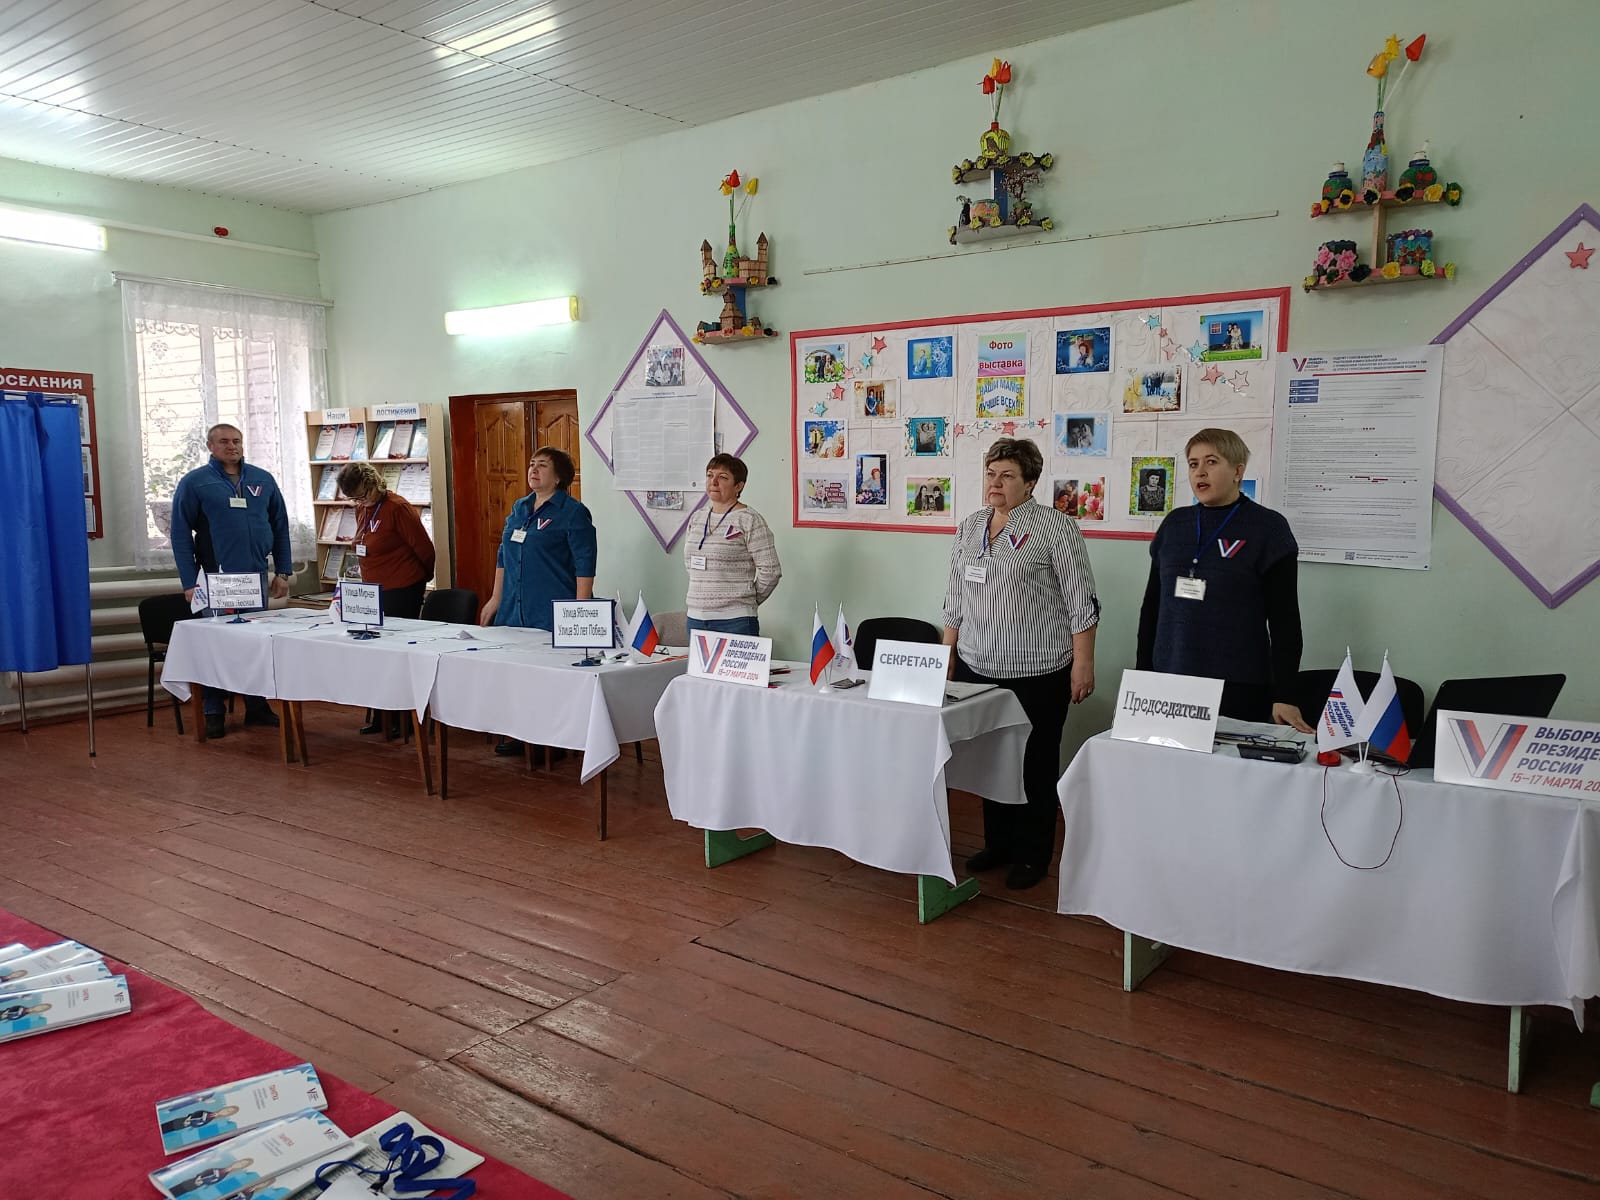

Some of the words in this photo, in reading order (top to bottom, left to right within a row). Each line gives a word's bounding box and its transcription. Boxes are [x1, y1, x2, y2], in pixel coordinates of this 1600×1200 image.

[989, 340, 1013, 350] Фото
[979, 360, 1023, 370] выставка
[326, 411, 346, 420] Наши
[562, 607, 577, 618] Улица
[558, 623, 572, 636] Улица
[589, 623, 607, 637] Победы
[729, 639, 760, 650] ВЫБОРЫ
[725, 649, 767, 662] ПРЕЗИДЕНТА
[879, 653, 943, 669] СЕКРЕТАРЬ
[720, 659, 749, 670] РОССИИ
[730, 670, 747, 678] МАРТА
[1122, 690, 1211, 720] Председатель
[1517, 757, 1584, 775] РОССИИ
[1542, 776, 1583, 791] МАРТА
